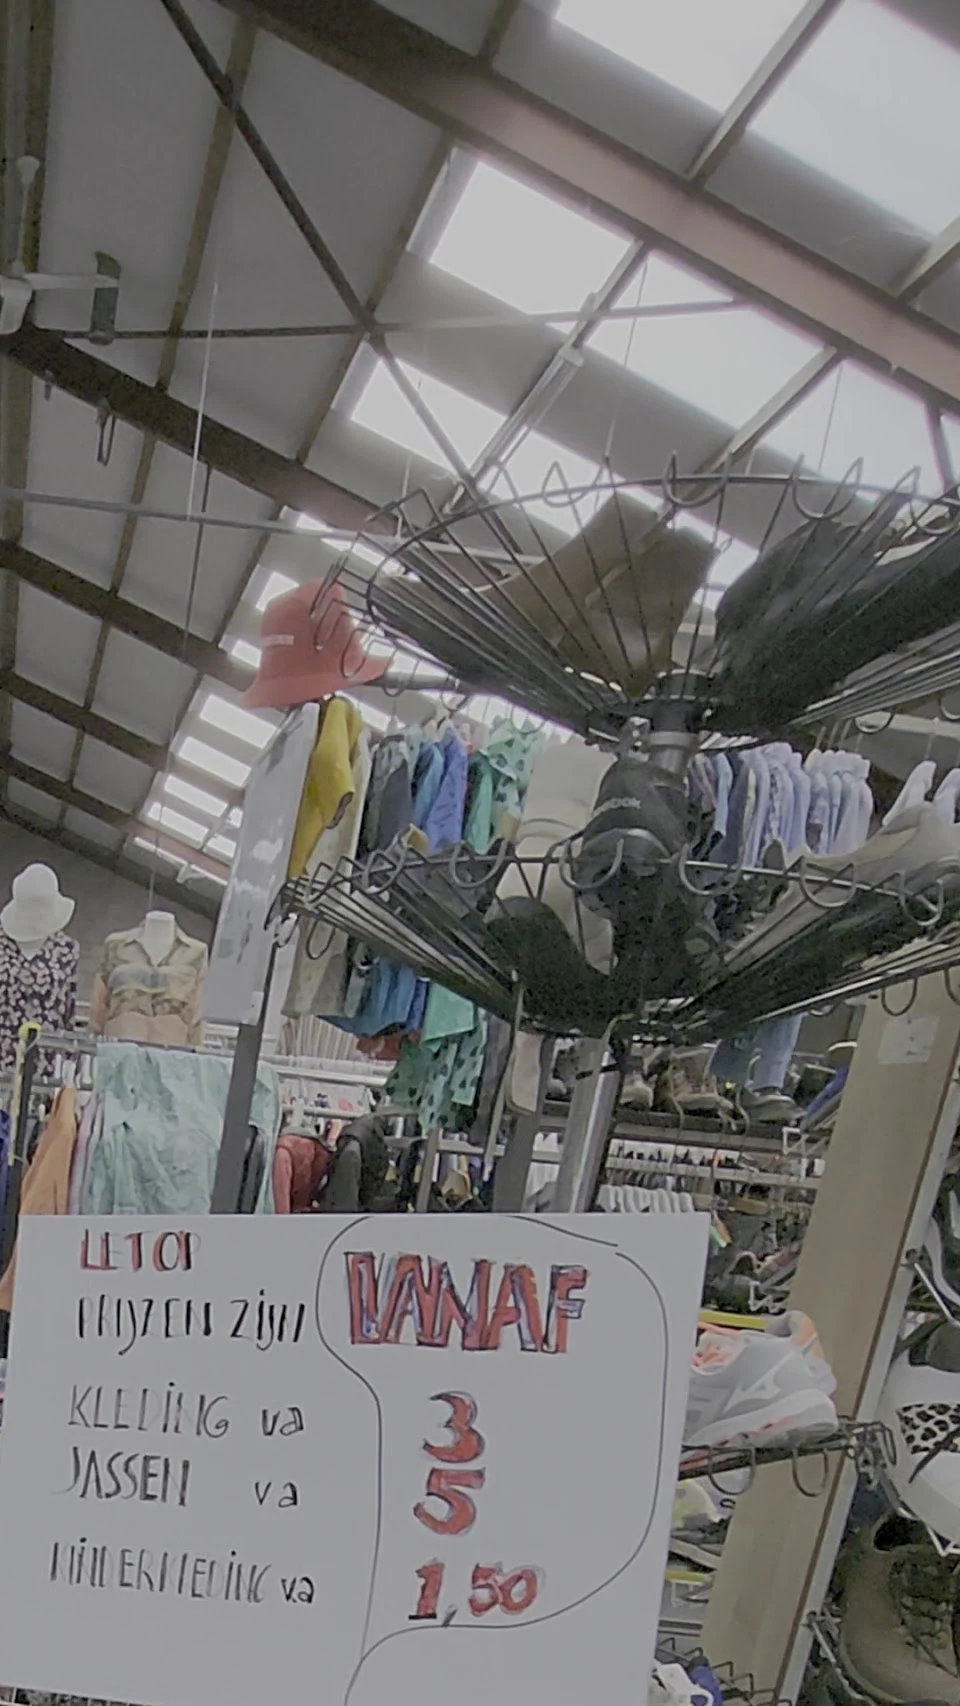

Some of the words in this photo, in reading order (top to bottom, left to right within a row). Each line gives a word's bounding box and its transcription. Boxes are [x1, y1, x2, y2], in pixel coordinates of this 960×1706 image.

[343, 1250, 589, 1354] VANAF
[422, 1390, 486, 1464] 3
[50, 1446, 191, 1507] JASSEN
[412, 1467, 486, 1536] 5
[408, 1557, 545, 1628] 1,50
